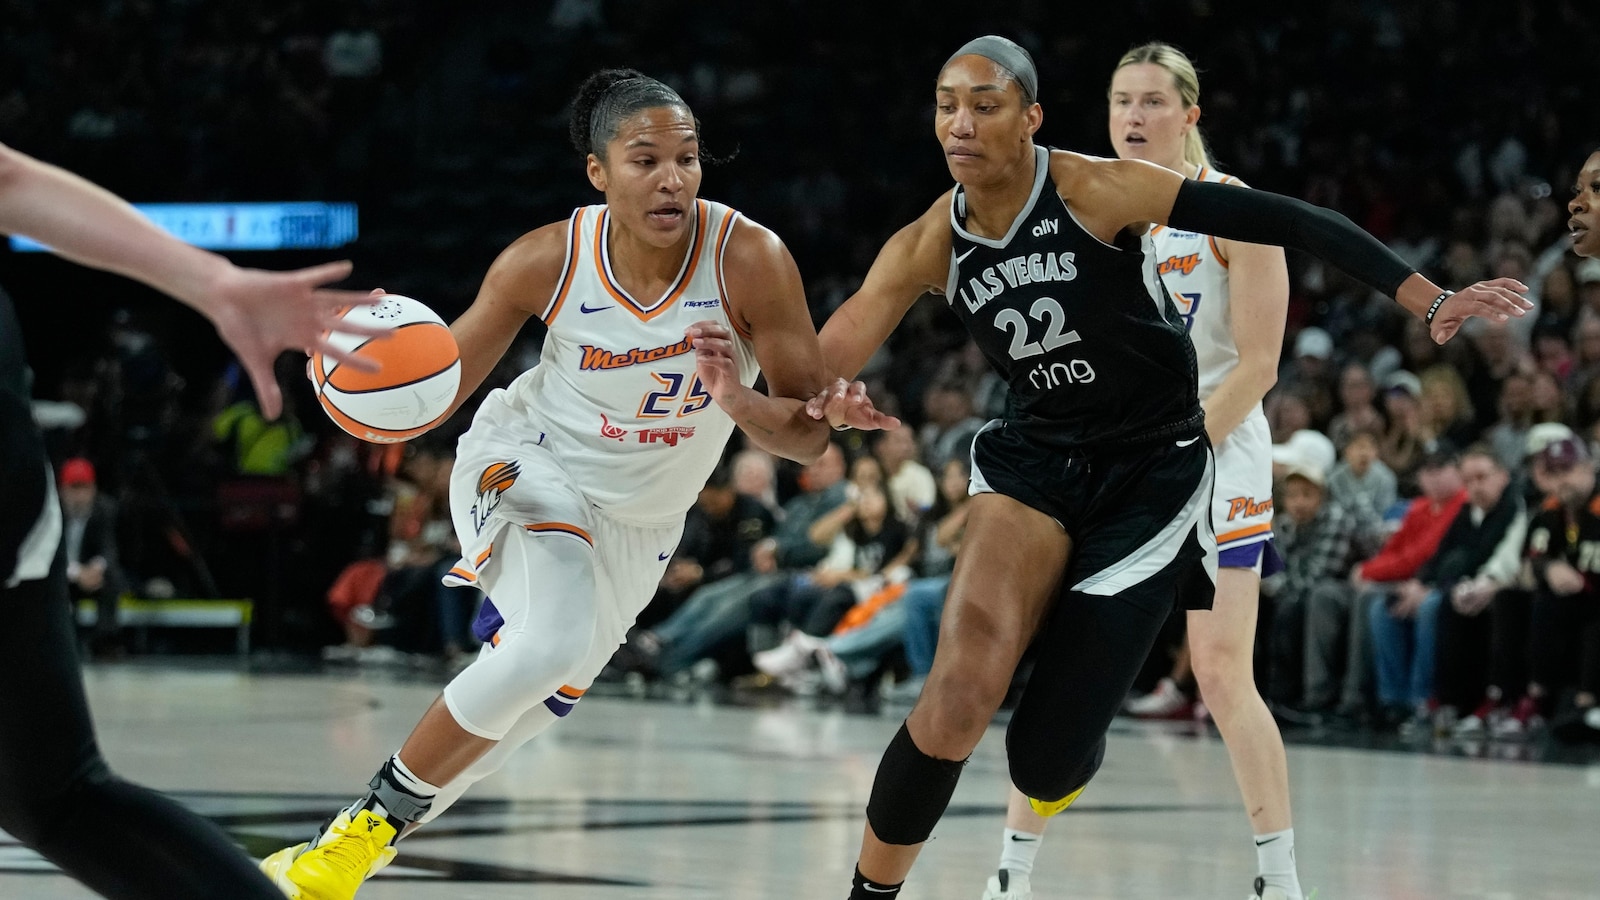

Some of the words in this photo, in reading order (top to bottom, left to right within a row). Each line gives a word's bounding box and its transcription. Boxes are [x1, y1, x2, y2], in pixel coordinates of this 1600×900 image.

[1032, 218, 1059, 237] ally
[959, 267, 1005, 314] LAS
[996, 252, 1078, 288] VEGAS
[994, 297, 1082, 361] 22
[636, 372, 713, 418] 25
[1029, 359, 1096, 390] ring
